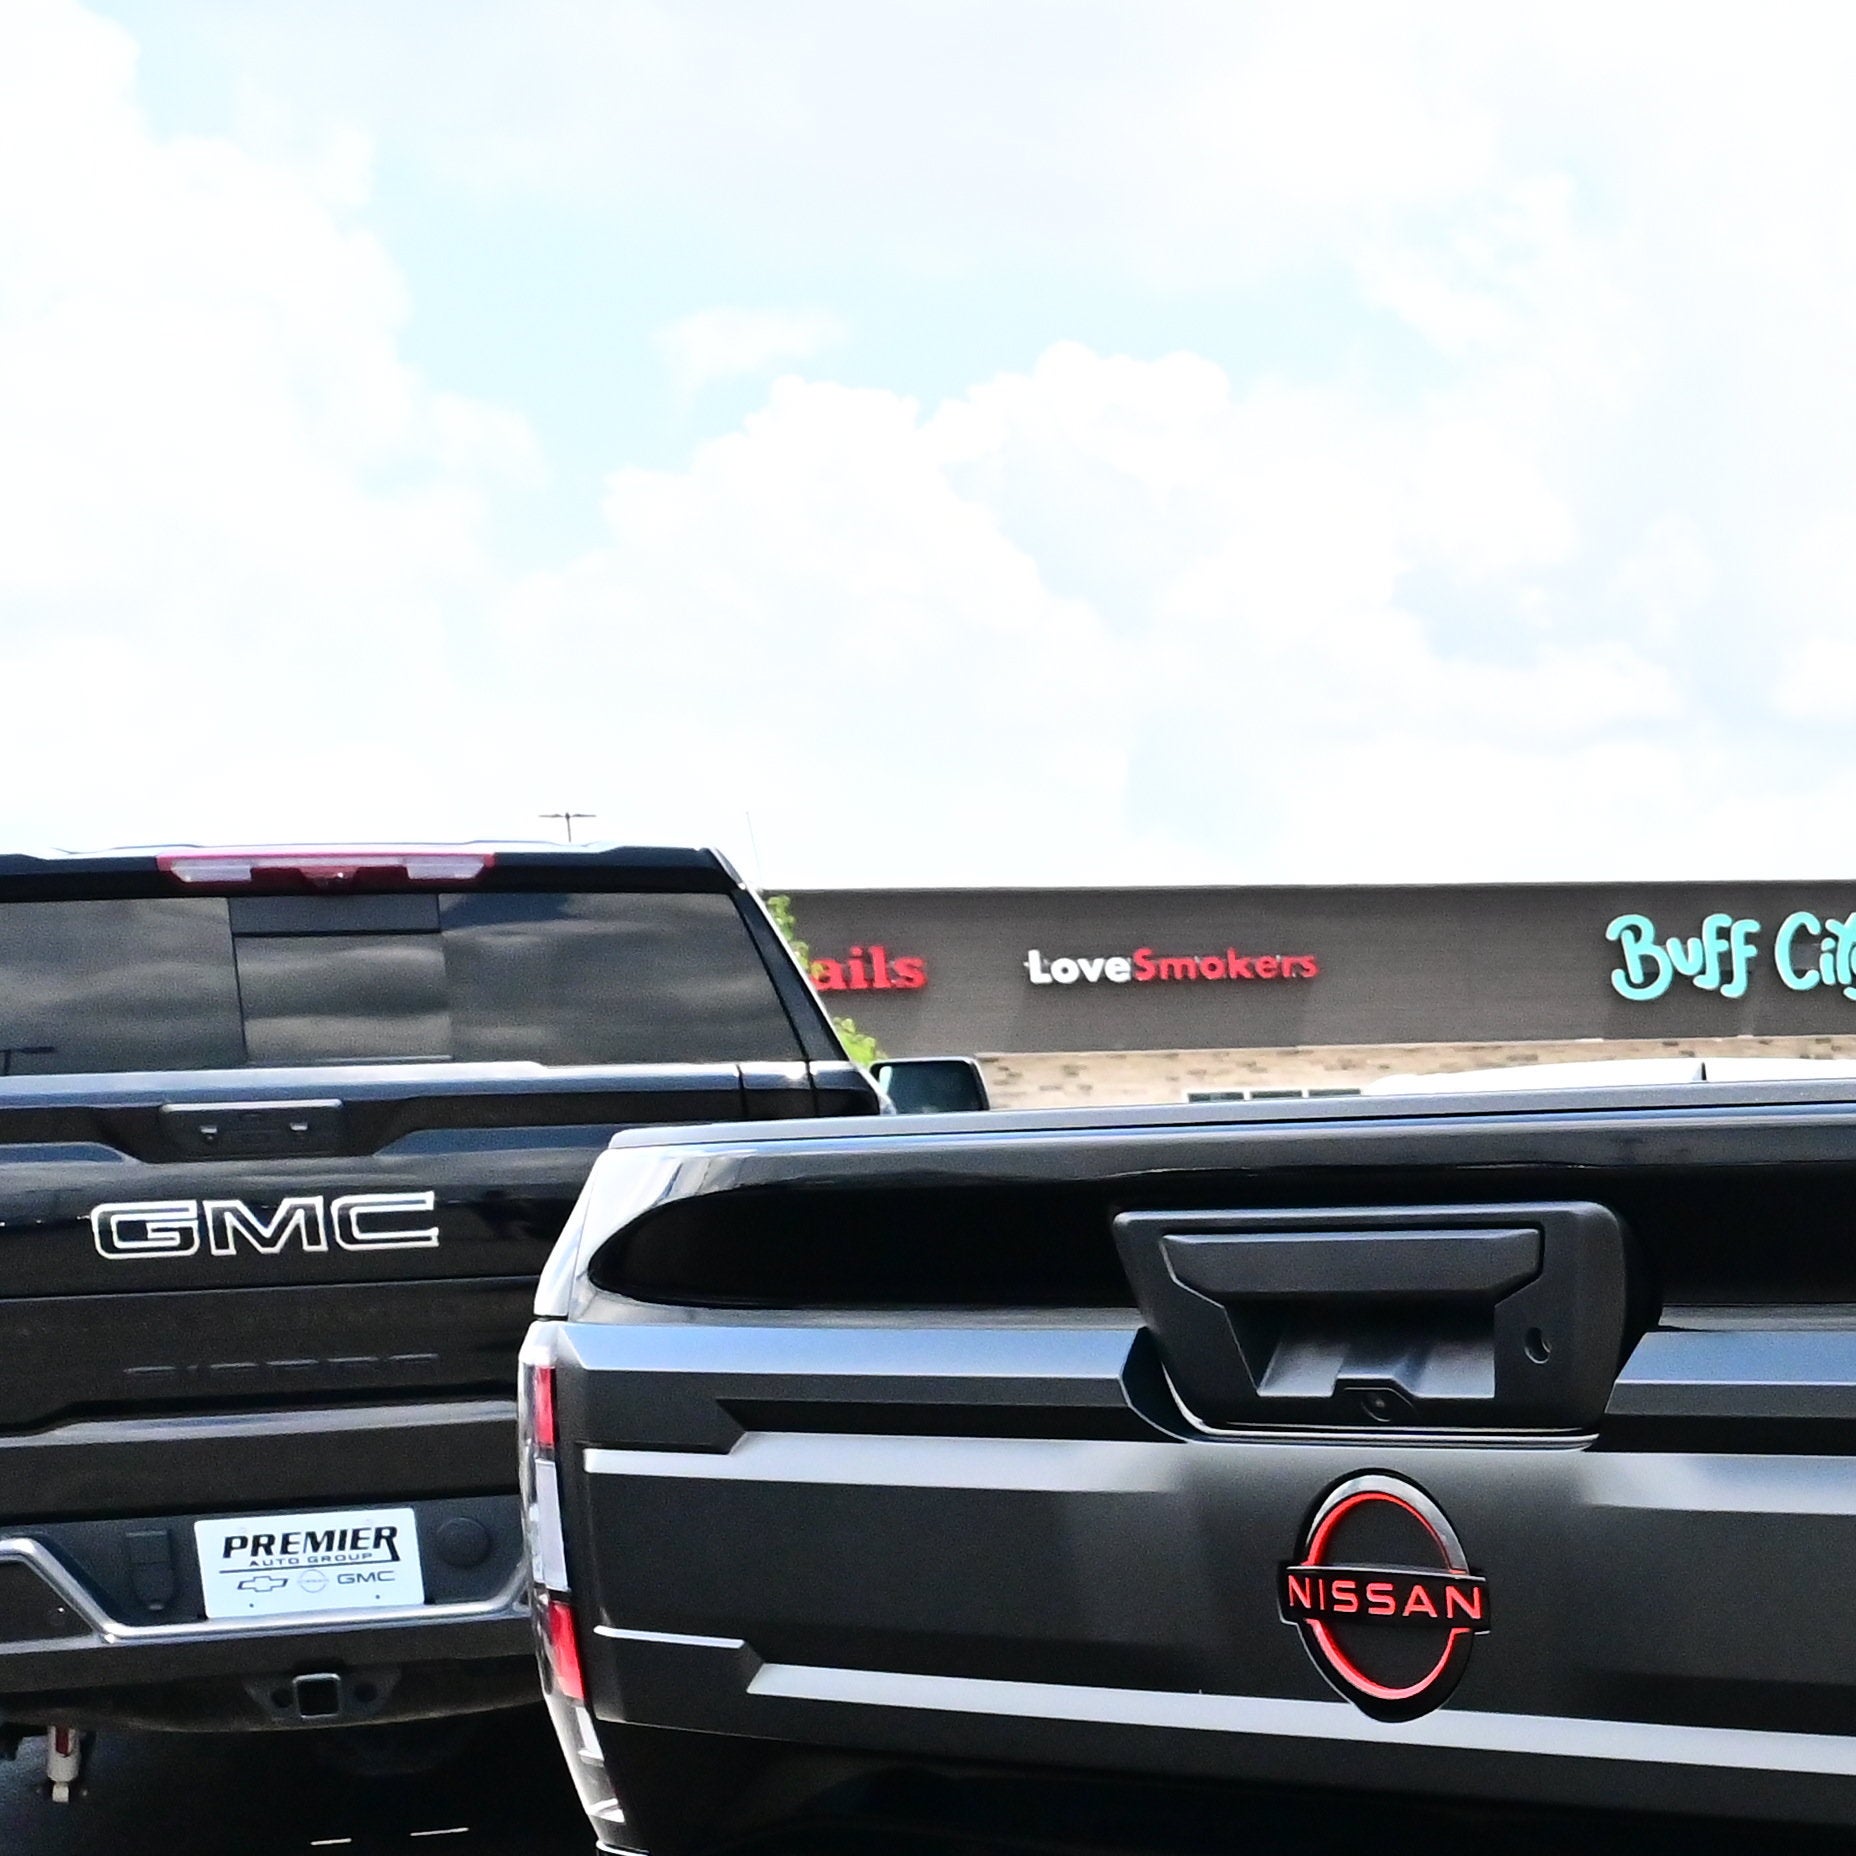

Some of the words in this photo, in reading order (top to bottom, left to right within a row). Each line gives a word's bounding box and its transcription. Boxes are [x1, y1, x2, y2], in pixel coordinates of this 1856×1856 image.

[809, 944, 928, 991] ails
[1026, 946, 1319, 986] LoveSmokers
[1605, 913, 1760, 1000] Buff
[90, 1191, 440, 1260] GMC
[222, 1526, 400, 1561] PREMIER
[249, 1558, 299, 1567] AUTO
[307, 1552, 373, 1563] GROUP
[337, 1570, 395, 1584] GMC
[1287, 1574, 1482, 1620] NISSAN
